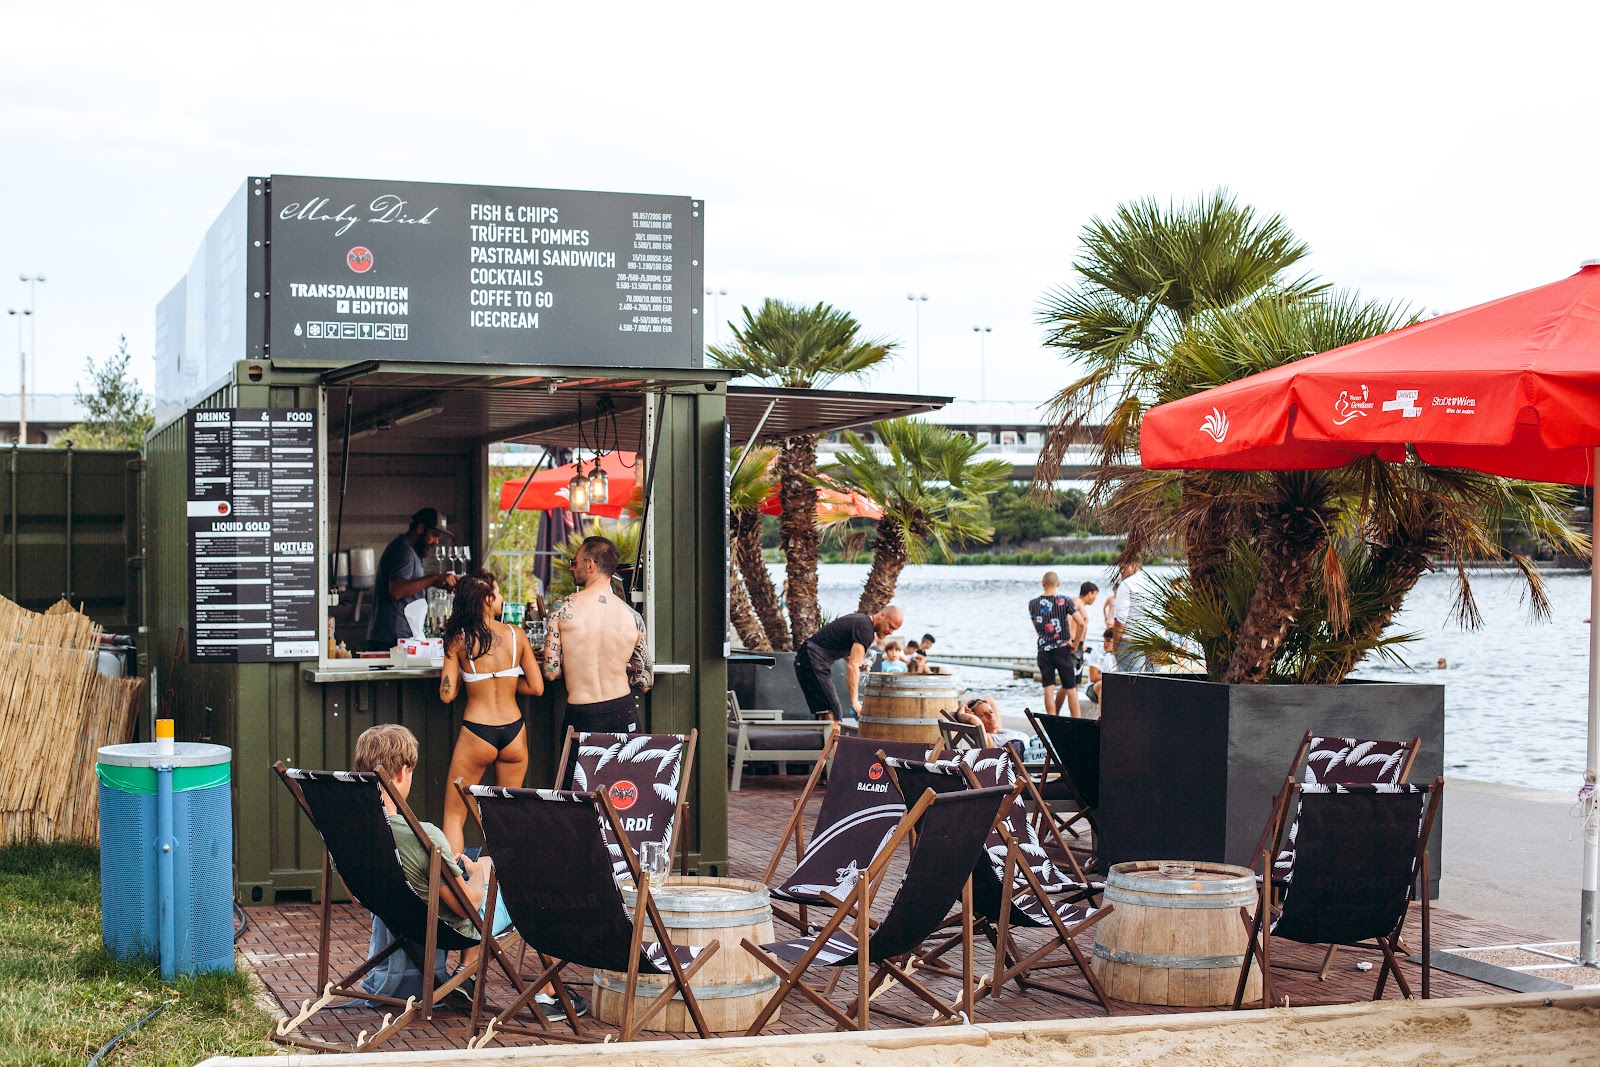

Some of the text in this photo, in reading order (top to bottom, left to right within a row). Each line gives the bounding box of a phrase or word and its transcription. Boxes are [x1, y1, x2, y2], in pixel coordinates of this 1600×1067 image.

[280, 194, 438, 237] Moby Dick
[470, 204, 558, 223] FISH & CHIPS
[662, 221, 672, 229] EUR
[470, 223, 589, 246] TRÜFFEL POMMES
[662, 234, 672, 242] TPP
[662, 242, 672, 250] EUR
[470, 247, 616, 268] PASTRAMI SANDWICH
[662, 255, 672, 263] SAS
[662, 263, 672, 271] EUR
[470, 268, 543, 286] COCKTAILS
[290, 283, 408, 300] TRANSDANUBIEN
[662, 283, 672, 291] EUR
[470, 289, 553, 308] COFFE TO GO
[352, 302, 408, 315] EDITION
[662, 304, 672, 312] EUR
[470, 310, 539, 329] ICECREAM
[662, 325, 672, 333] EUR
[196, 412, 313, 422] DRINKS & FOOD
[212, 522, 271, 532] LIQUID GOLD
[273, 541, 315, 552] BOTTLED
[856, 781, 890, 793] BACARDÍ
